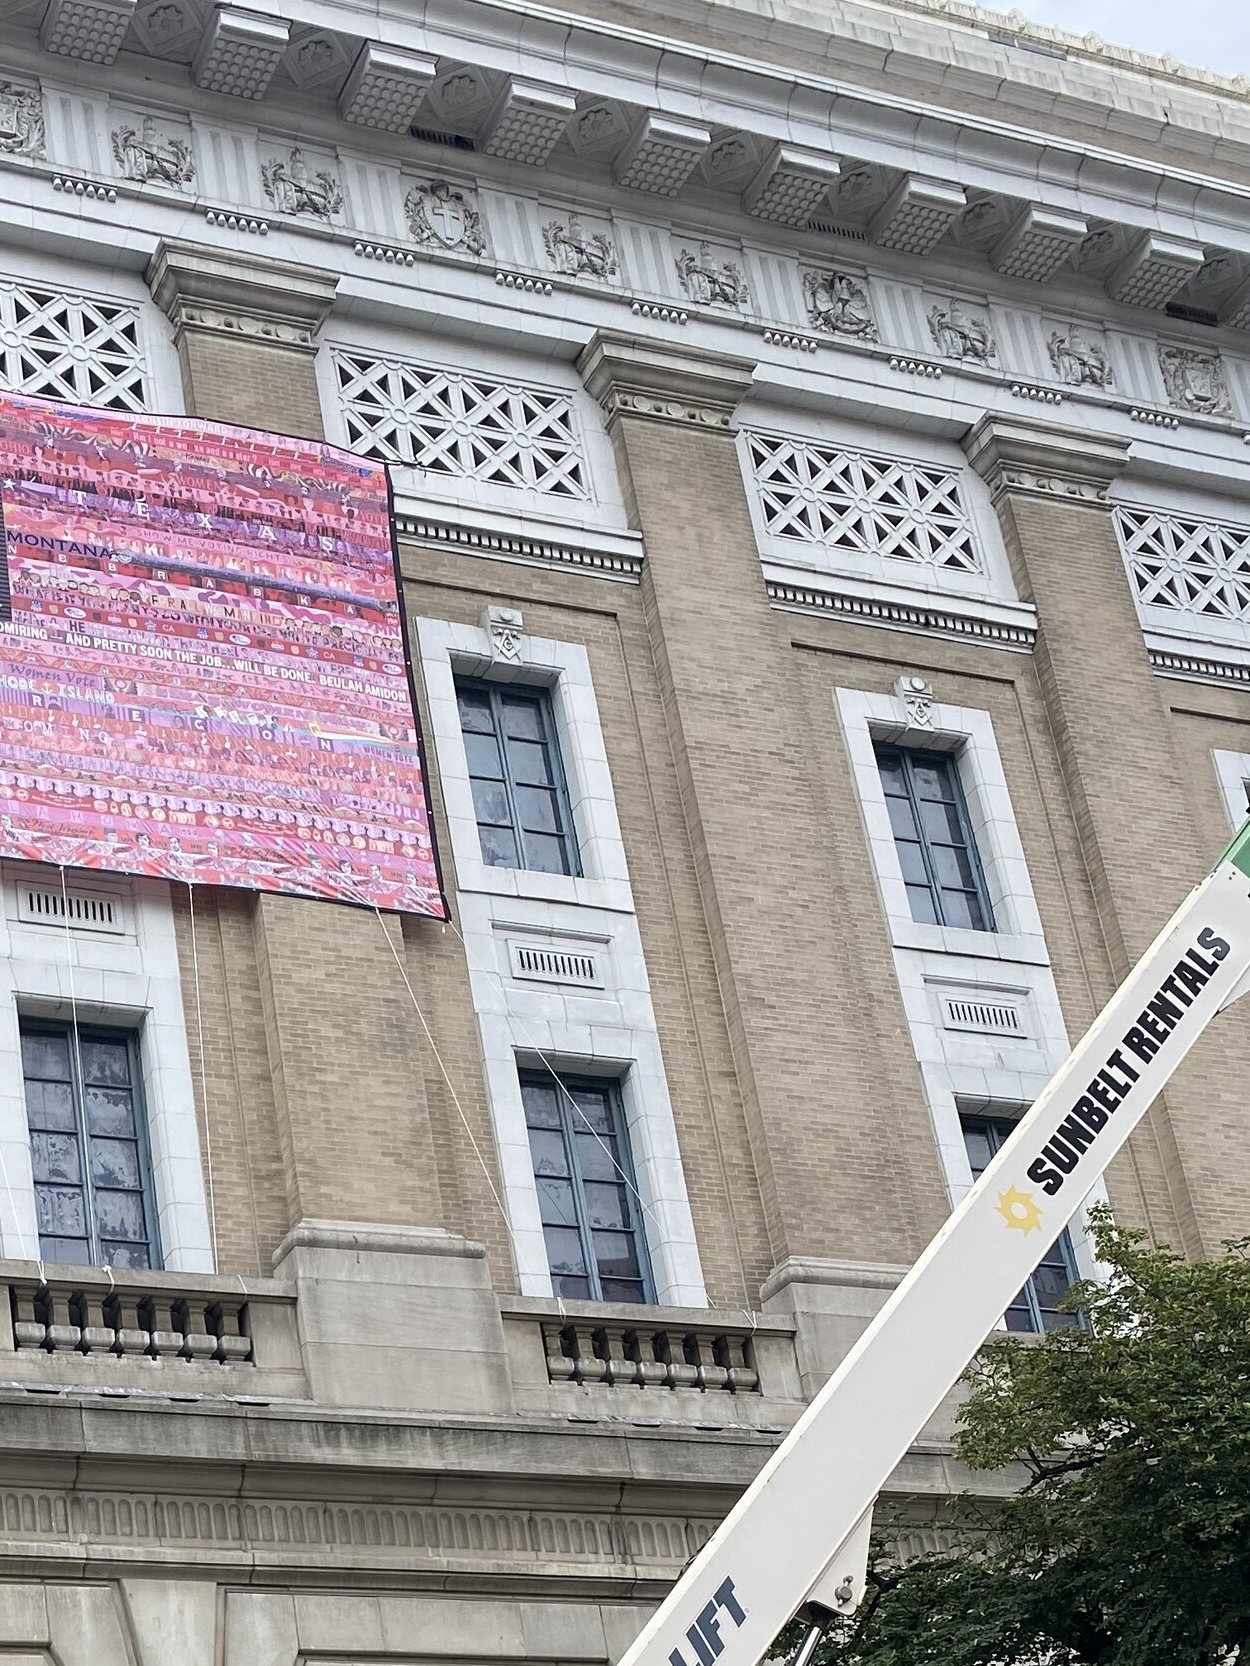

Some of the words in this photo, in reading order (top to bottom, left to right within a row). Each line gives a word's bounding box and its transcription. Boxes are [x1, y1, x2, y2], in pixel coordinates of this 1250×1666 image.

[0, 440, 30, 454] OHIO
[178, 474, 222, 492] WOMEN
[7, 530, 112, 558] MONTANA
[138, 529, 172, 542] SHOW
[177, 537, 195, 548] ME
[8, 663, 62, 681] Women
[66, 672, 96, 688] Vote
[66, 633, 91, 648] AND
[93, 637, 137, 655] PRETTY
[139, 646, 172, 660] SOON
[175, 651, 198, 664] THE
[263, 665, 279, 678] BE
[319, 675, 363, 693] BEULAH
[364, 684, 407, 702] AMIDON
[56, 683, 115, 703] ISLAND
[1026, 1048, 1141, 1196] SUNBELT
[1121, 926, 1231, 1065] RENTALS
